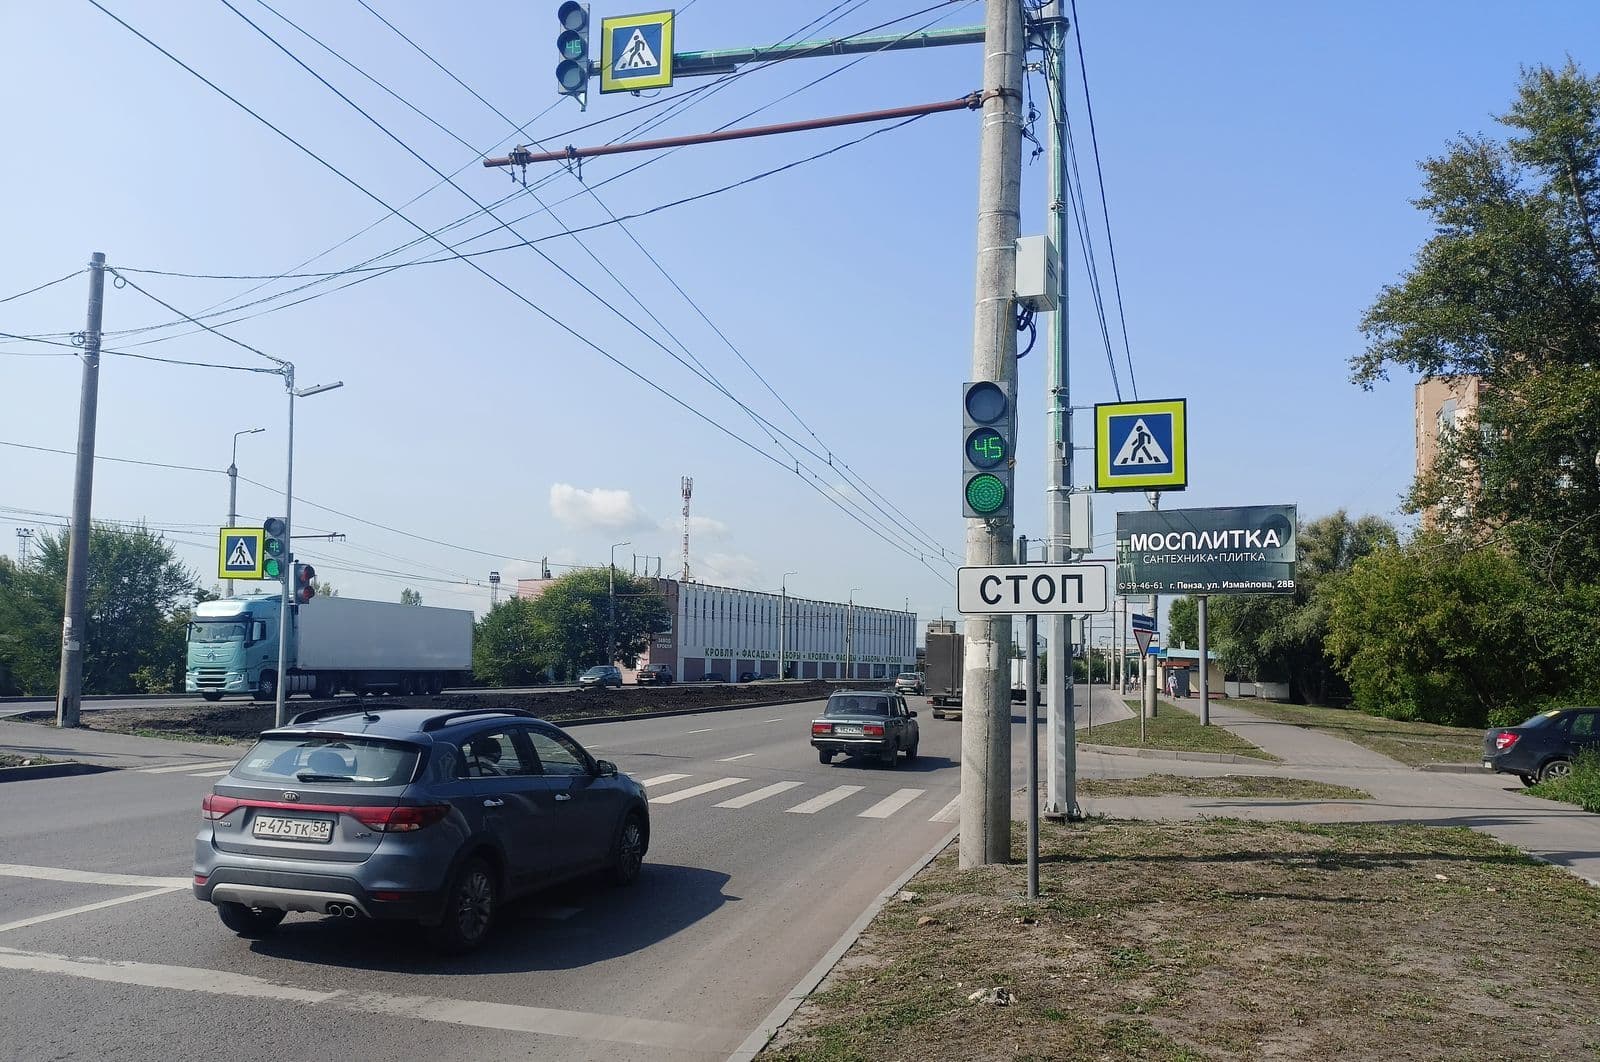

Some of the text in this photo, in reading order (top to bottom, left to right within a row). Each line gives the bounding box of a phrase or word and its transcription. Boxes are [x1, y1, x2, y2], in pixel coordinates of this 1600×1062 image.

[565, 39, 582, 54] 45
[974, 437, 1002, 458] 45
[1130, 528, 1281, 552] МОСПЛИТКА
[979, 574, 1084, 605] СТОП
[1126, 582, 1164, 590] 59-46-61
[1176, 581, 1205, 590] Пенза,
[1206, 582, 1220, 591] ул.
[1222, 580, 1275, 590] Измайлова,
[704, 648, 734, 657] КРОВЛЯ
[741, 649, 770, 659] ФАСАДЫ
[778, 650, 801, 659] ЗБОРЫ
[835, 654, 857, 662] ФАСДЫ
[284, 793, 297, 801] KIA
[312, 821, 327, 833] 58
